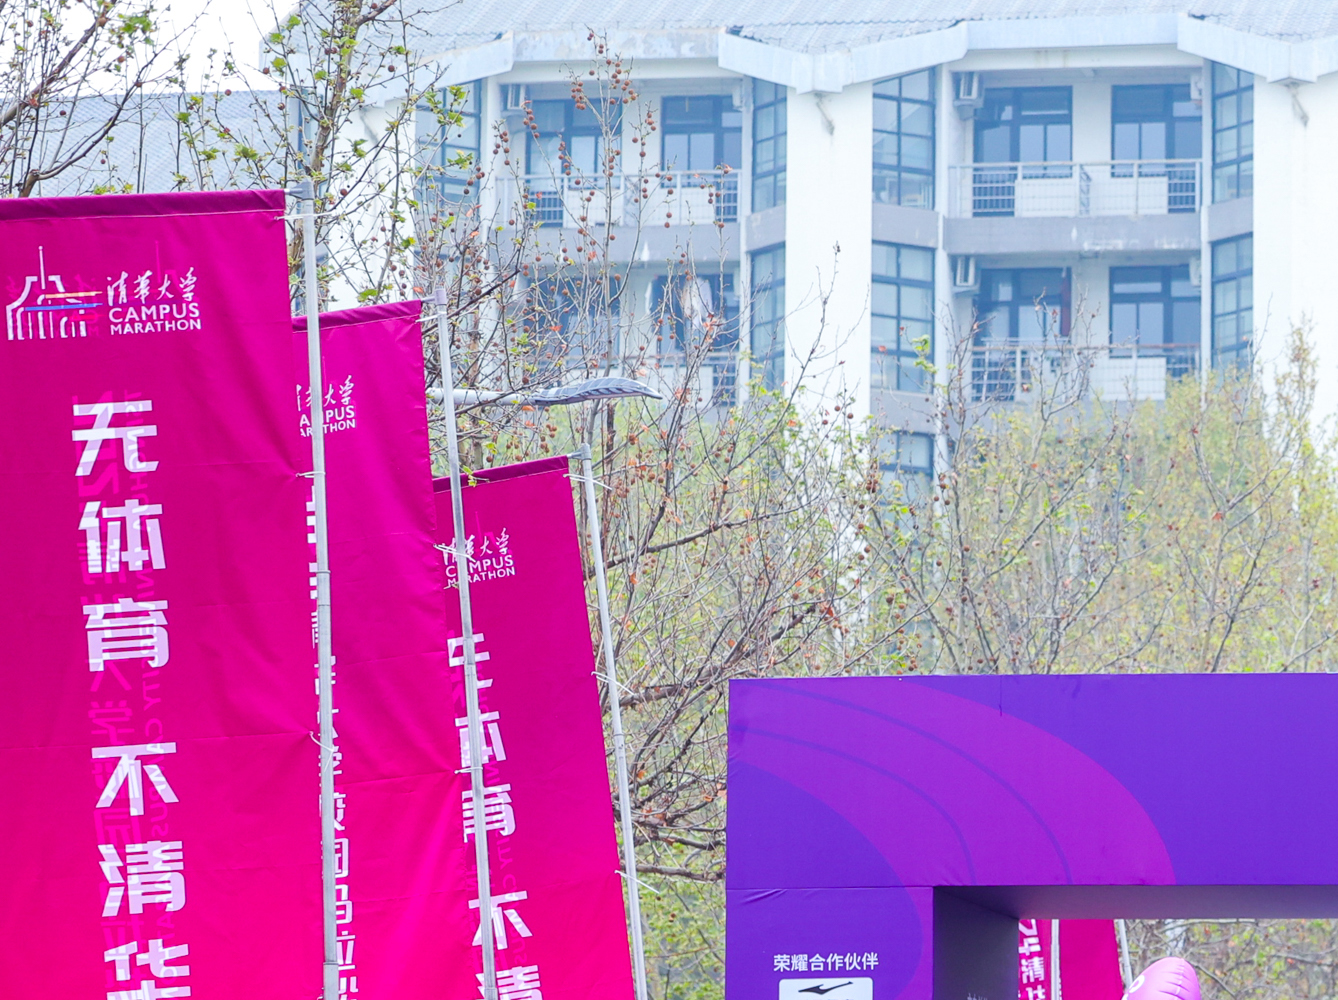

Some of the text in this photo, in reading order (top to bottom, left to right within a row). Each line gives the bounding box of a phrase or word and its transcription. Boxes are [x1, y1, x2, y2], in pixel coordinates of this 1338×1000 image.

[109, 302, 200, 323] CAMPUS
[110, 318, 202, 335] MARATHON
[445, 554, 514, 578] CMPUS
[447, 565, 516, 587] MRATHON
[773, 952, 879, 973] 荣耀合作伙伴
